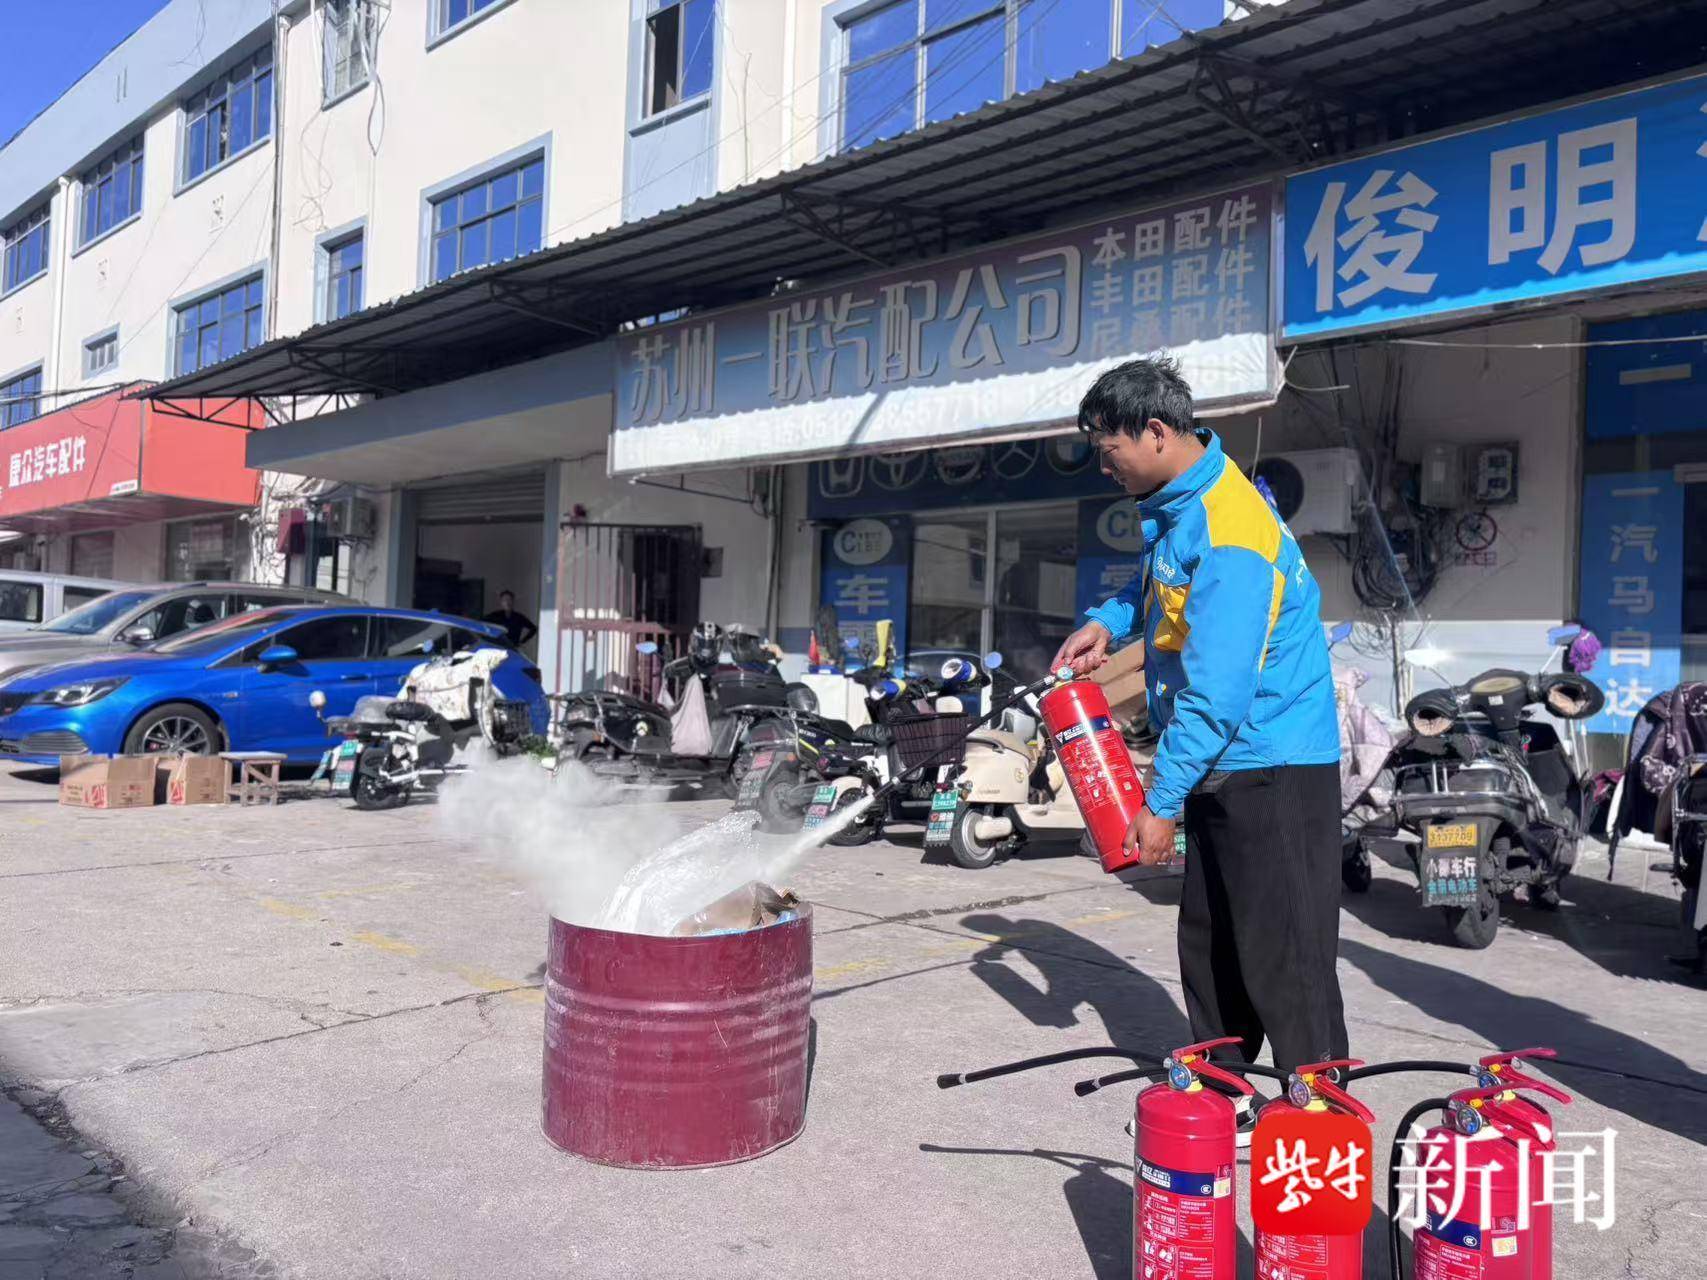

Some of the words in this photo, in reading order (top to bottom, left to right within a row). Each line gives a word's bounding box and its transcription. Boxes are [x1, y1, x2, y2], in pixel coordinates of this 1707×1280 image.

[1089, 243, 1255, 314] 丰田配件
[1091, 195, 1257, 270] 本田配件
[1303, 98, 1707, 313] 俊明
[630, 243, 1083, 424] 苏州一联汽配公司
[1605, 486, 1661, 718] 一汽马自达
